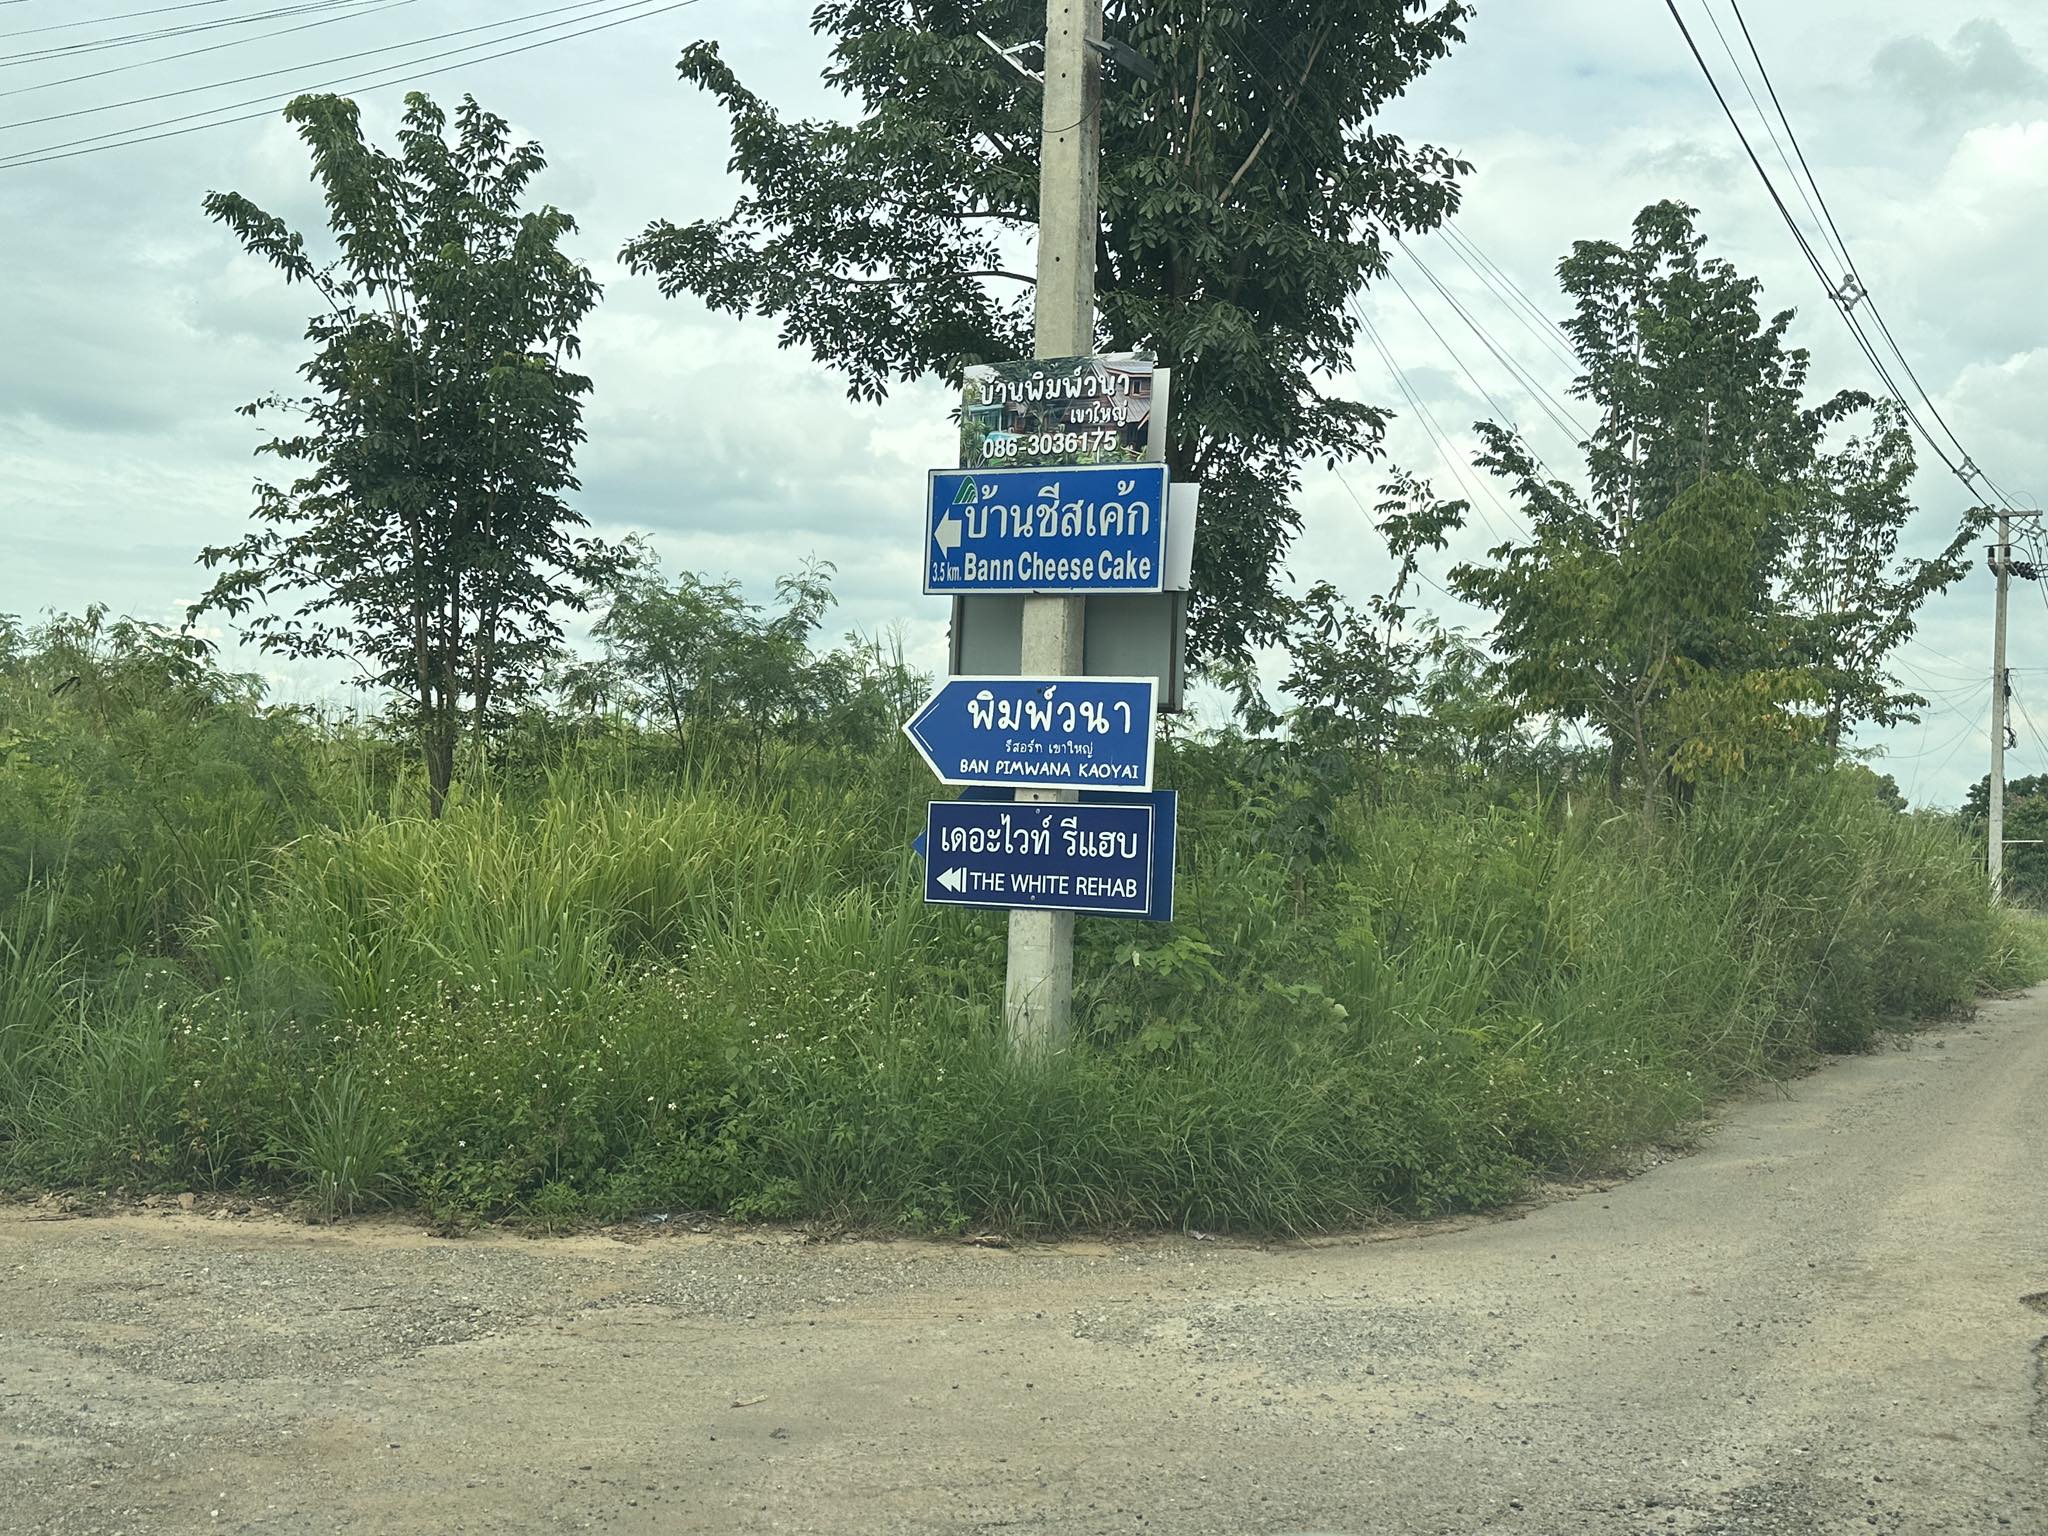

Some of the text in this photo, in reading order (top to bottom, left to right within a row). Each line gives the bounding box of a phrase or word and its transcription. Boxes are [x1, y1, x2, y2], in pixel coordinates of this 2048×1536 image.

[979, 366, 1130, 405] บ้านพิมพ์วนา
[1070, 401, 1128, 428] เขาใหญ่
[982, 431, 1117, 459] 086-3036175
[965, 479, 1149, 539] บ้านชีสเค้ก
[932, 561, 962, 582] 3.5 km.
[964, 550, 1151, 581] Bann Cheese Cake
[967, 684, 1132, 735] พิมพ์วนา
[1048, 740, 1094, 759] เขาใหญ่
[960, 759, 1139, 779] BAN PIMWANA KAOYAI
[941, 813, 1138, 859] เดอะไวท์ รีแฮบ
[970, 872, 1137, 898] THE WHITE REHAB
